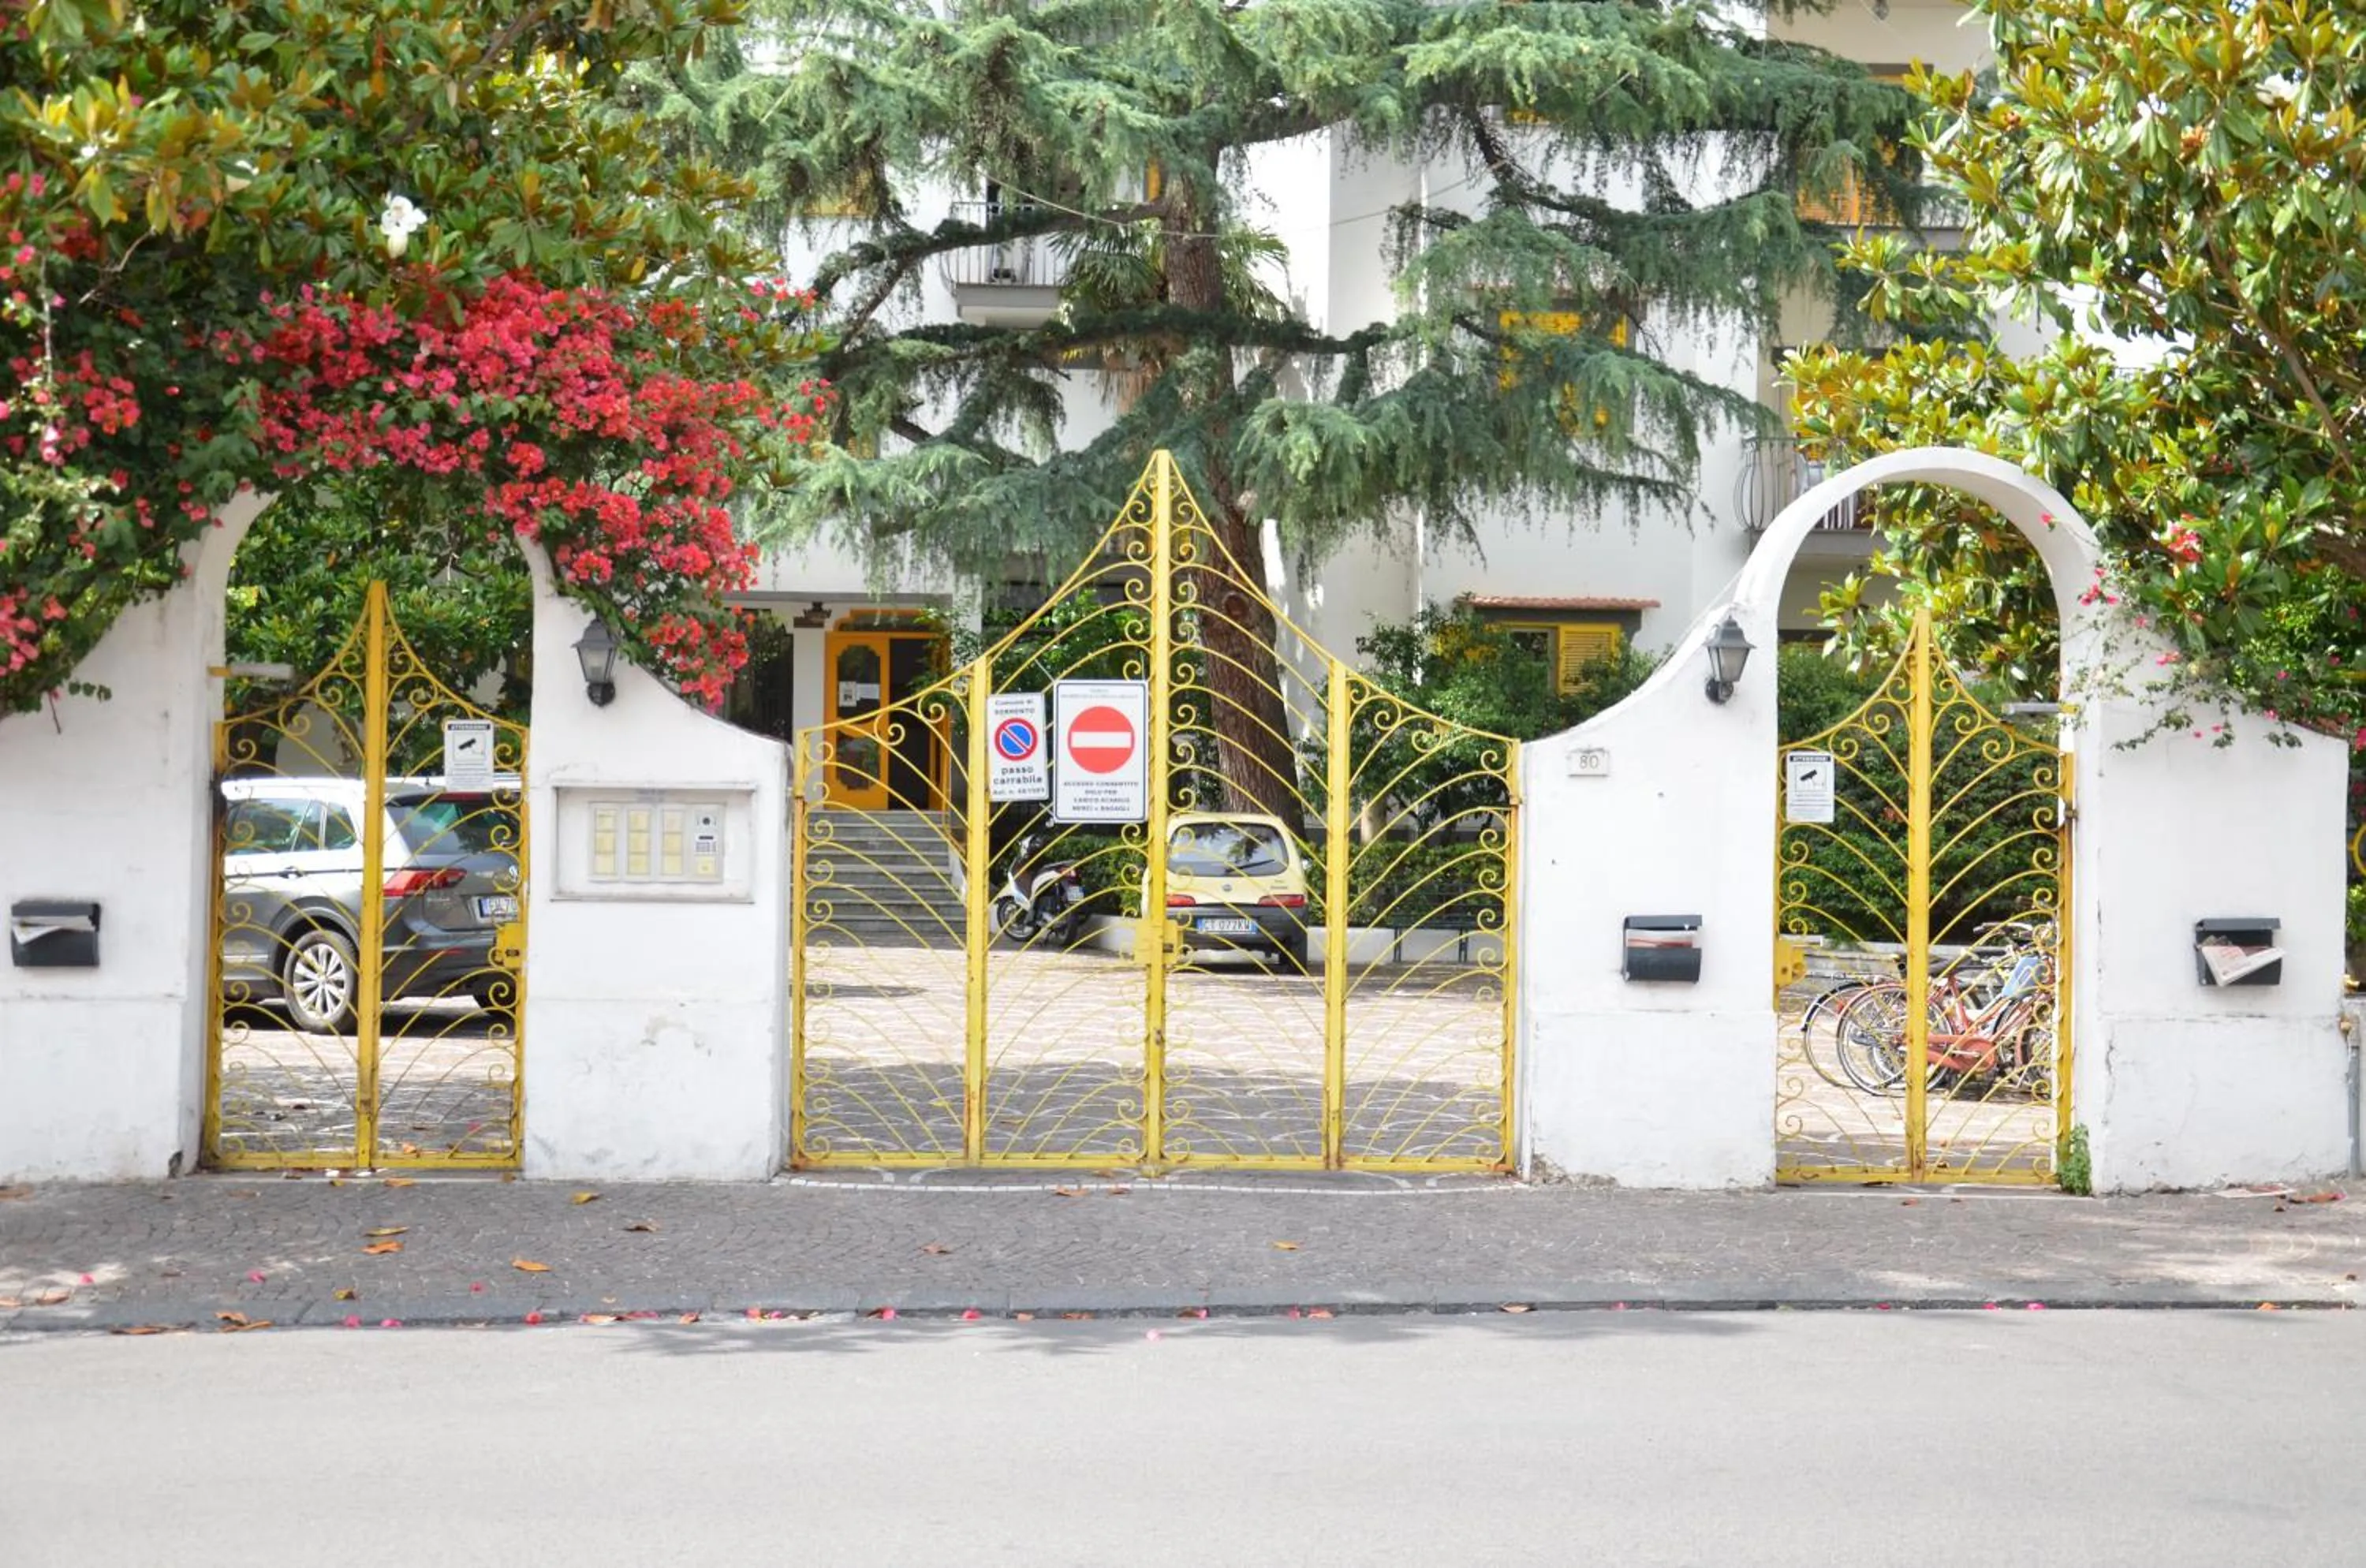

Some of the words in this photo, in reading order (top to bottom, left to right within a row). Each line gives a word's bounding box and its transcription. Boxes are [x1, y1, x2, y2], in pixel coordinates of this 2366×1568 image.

[1579, 755, 1599, 770] 80
[1001, 765, 1034, 775] passo
[993, 775, 1043, 785] carrabile
